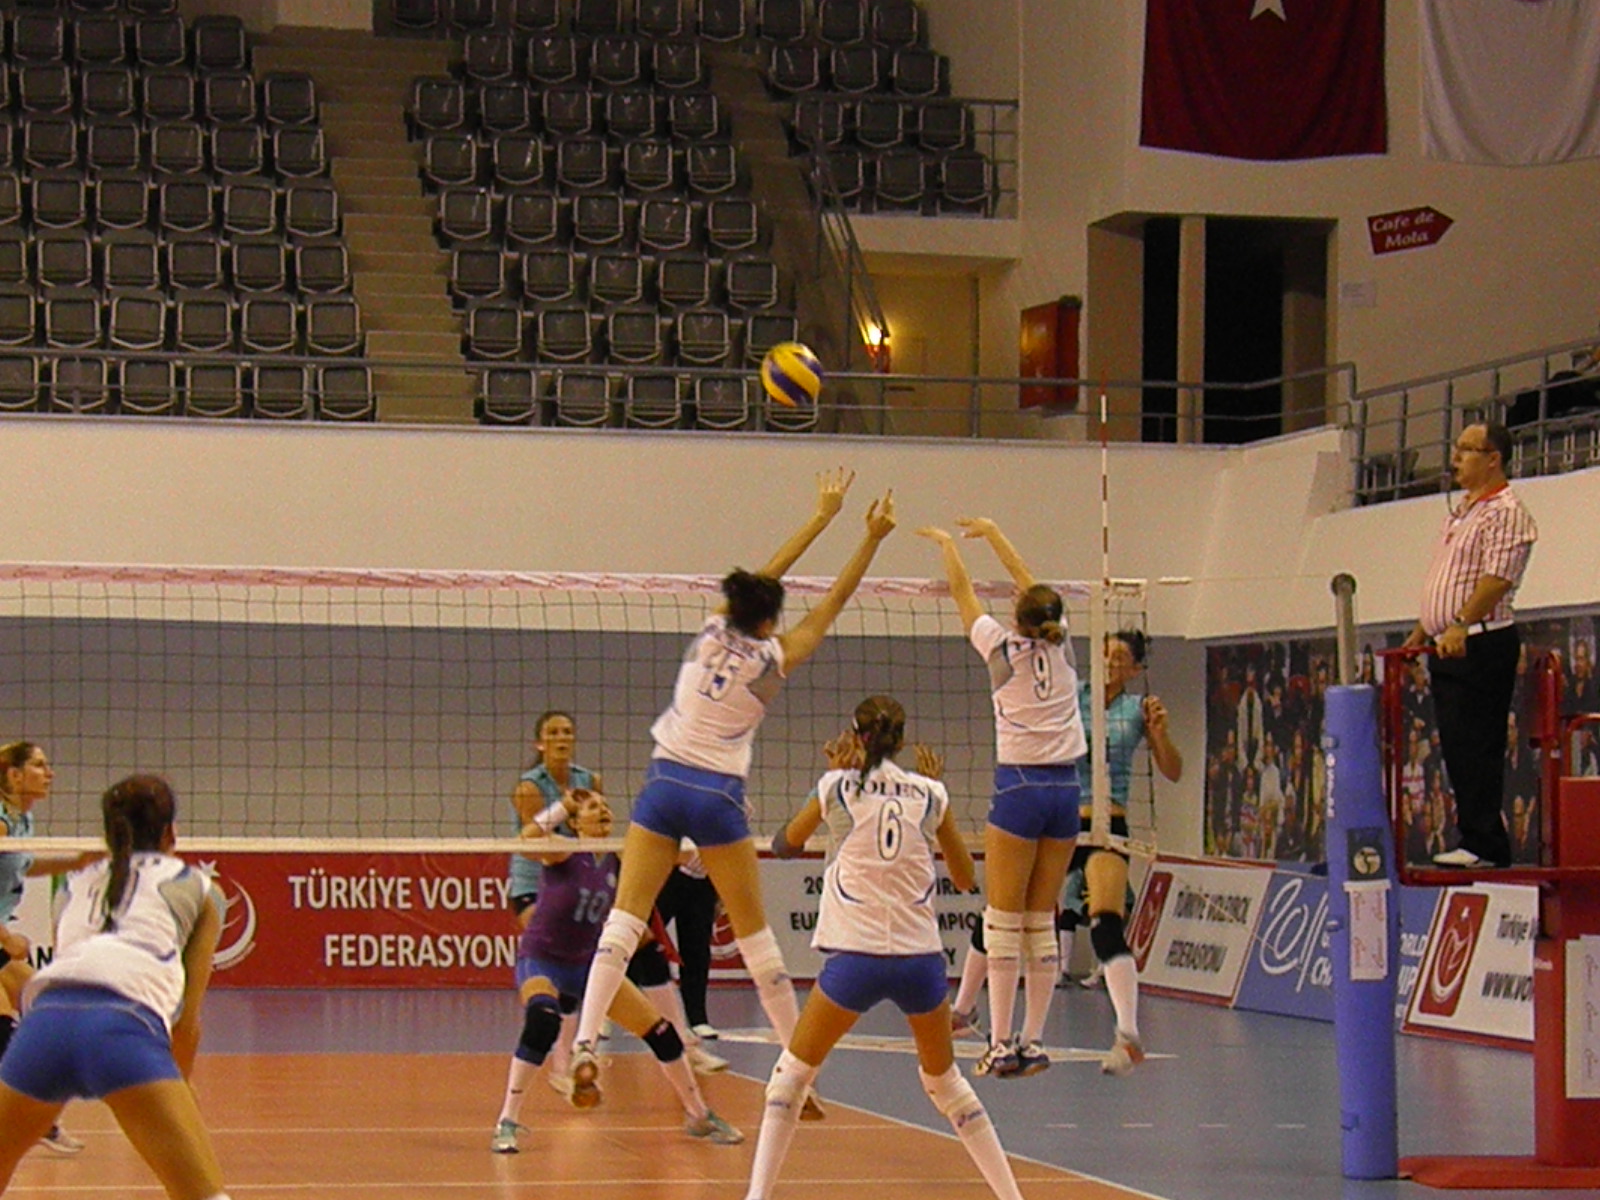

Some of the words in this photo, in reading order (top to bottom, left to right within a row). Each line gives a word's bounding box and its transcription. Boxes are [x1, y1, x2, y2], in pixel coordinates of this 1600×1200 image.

[1372, 215, 1411, 232] Cafe
[1414, 212, 1435, 225] de
[1384, 231, 1429, 249] Mola
[1032, 644, 1052, 701] 9
[877, 797, 903, 861] 6
[288, 867, 413, 910] TÜRKİYE
[419, 877, 513, 911] VOLEY
[573, 887, 610, 924] 10
[324, 933, 525, 969] FEDERASYON
